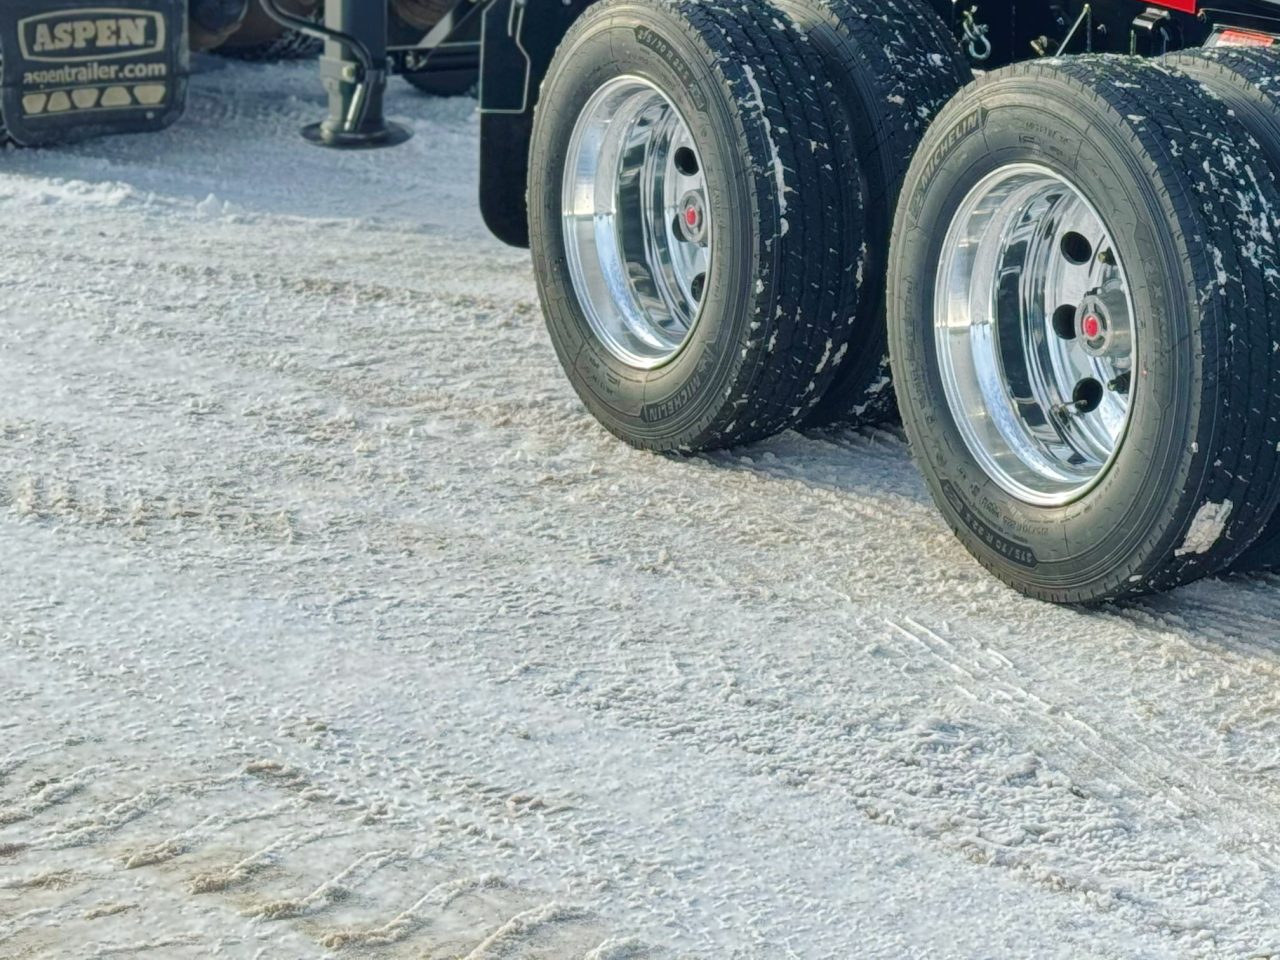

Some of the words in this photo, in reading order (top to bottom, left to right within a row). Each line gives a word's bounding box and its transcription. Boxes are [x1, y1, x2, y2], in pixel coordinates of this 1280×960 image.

[33, 18, 147, 52] ASPEN
[23, 62, 166, 86] aspentrailer.com
[921, 113, 977, 190] MICHELIN
[648, 374, 701, 422] MICHELIN
